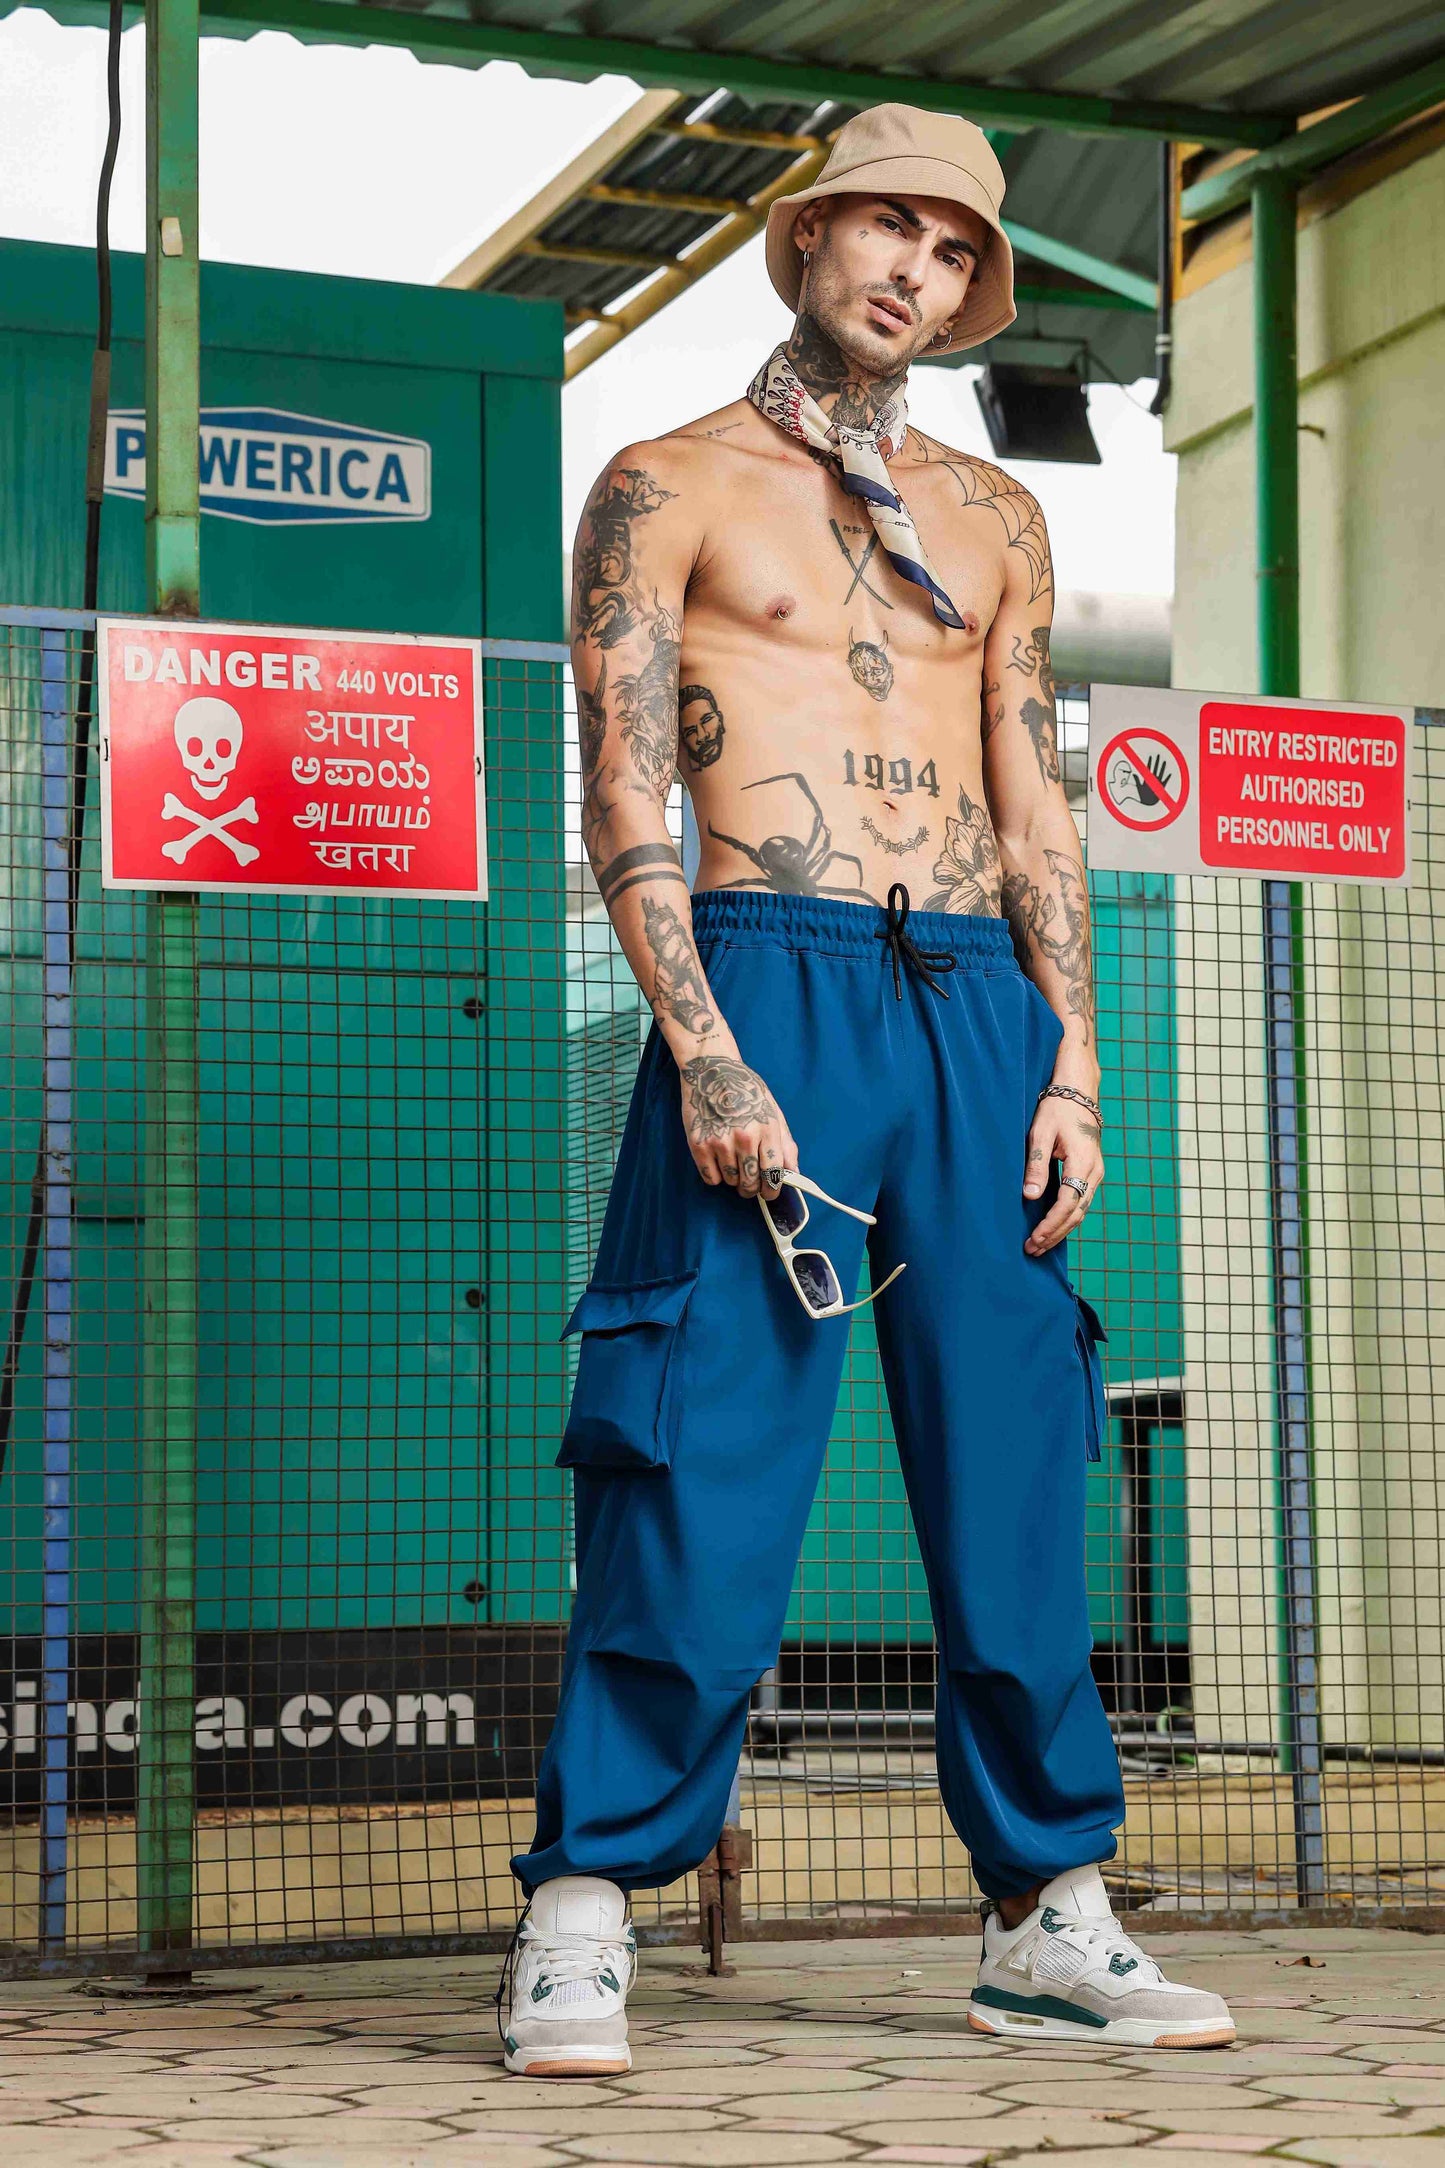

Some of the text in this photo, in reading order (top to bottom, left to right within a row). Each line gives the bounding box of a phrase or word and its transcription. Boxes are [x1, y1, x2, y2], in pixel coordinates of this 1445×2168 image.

[116, 428, 411, 503] PWERICA
[124, 646, 459, 699] DANGER 440 VOLTS
[304, 710, 416, 750] अपाय
[1209, 727, 1398, 767] ENTRY RESTRICTED
[291, 753, 430, 790] ಅಪಾಯ
[842, 748, 940, 798] 1994
[1240, 774, 1365, 808] AUTHORISED
[292, 795, 431, 832] அபாயம்
[1217, 816, 1391, 853] PERSONNEL ONLY
[308, 841, 416, 873] खतरा
